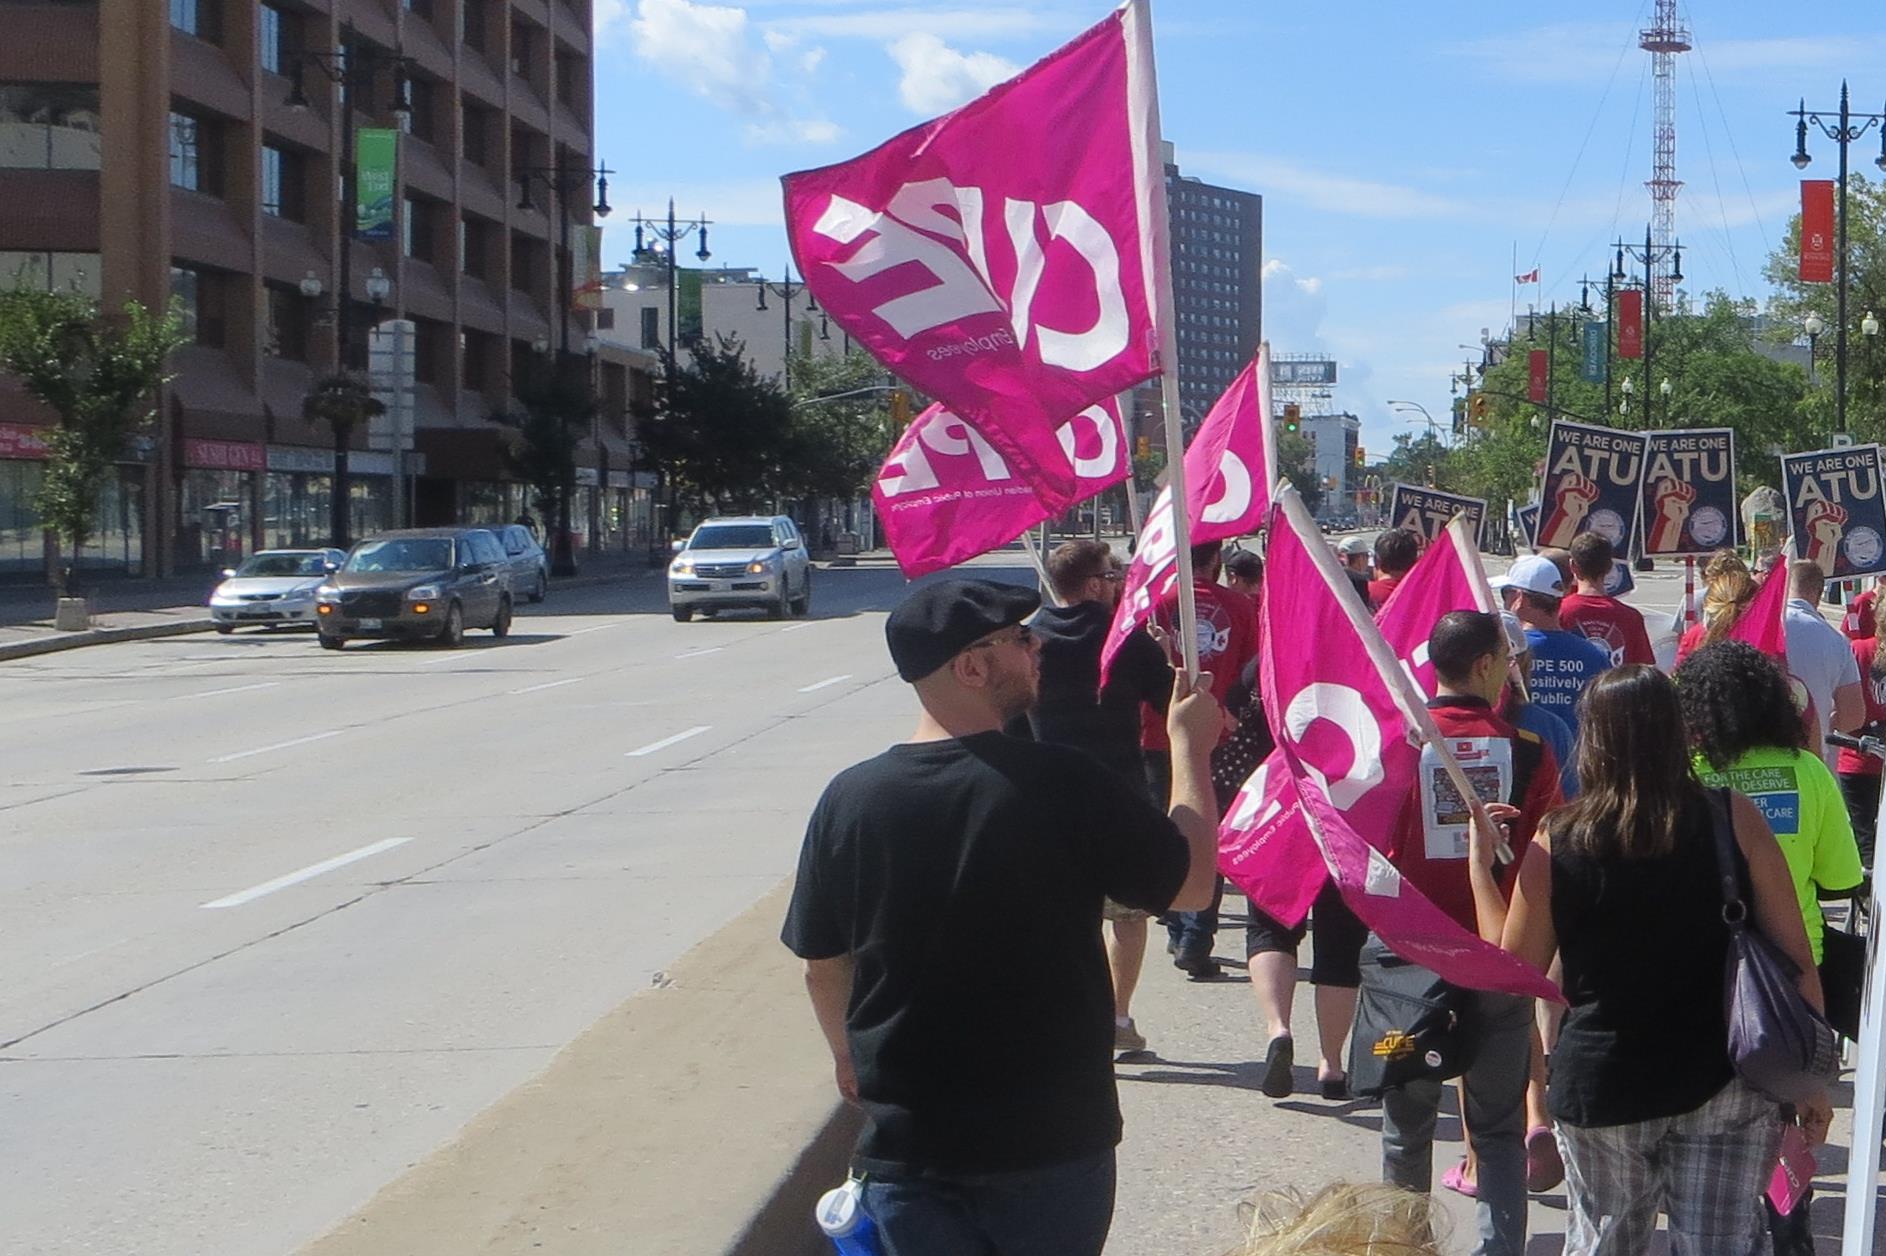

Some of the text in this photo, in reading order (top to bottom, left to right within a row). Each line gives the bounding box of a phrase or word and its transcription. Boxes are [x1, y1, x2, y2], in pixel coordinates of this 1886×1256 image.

[1558, 430, 1641, 454] WE ARE ONE
[1671, 438, 1697, 450] ARE
[1700, 437, 1727, 449] ONE
[1552, 445, 1639, 486] ATU
[1647, 450, 1728, 483] ATU
[1790, 454, 1875, 475] WE ARE ONE
[1795, 467, 1877, 508] ATU
[1401, 491, 1479, 519] WE ARE ONE
[1559, 660, 1584, 672] 500
[1529, 675, 1585, 692] ositively
[1531, 692, 1572, 704] Public
[1729, 770, 1751, 781] THE
[1752, 768, 1782, 779] CARE
[1742, 778, 1791, 791] DESERVE
[1765, 807, 1793, 819] CARE
